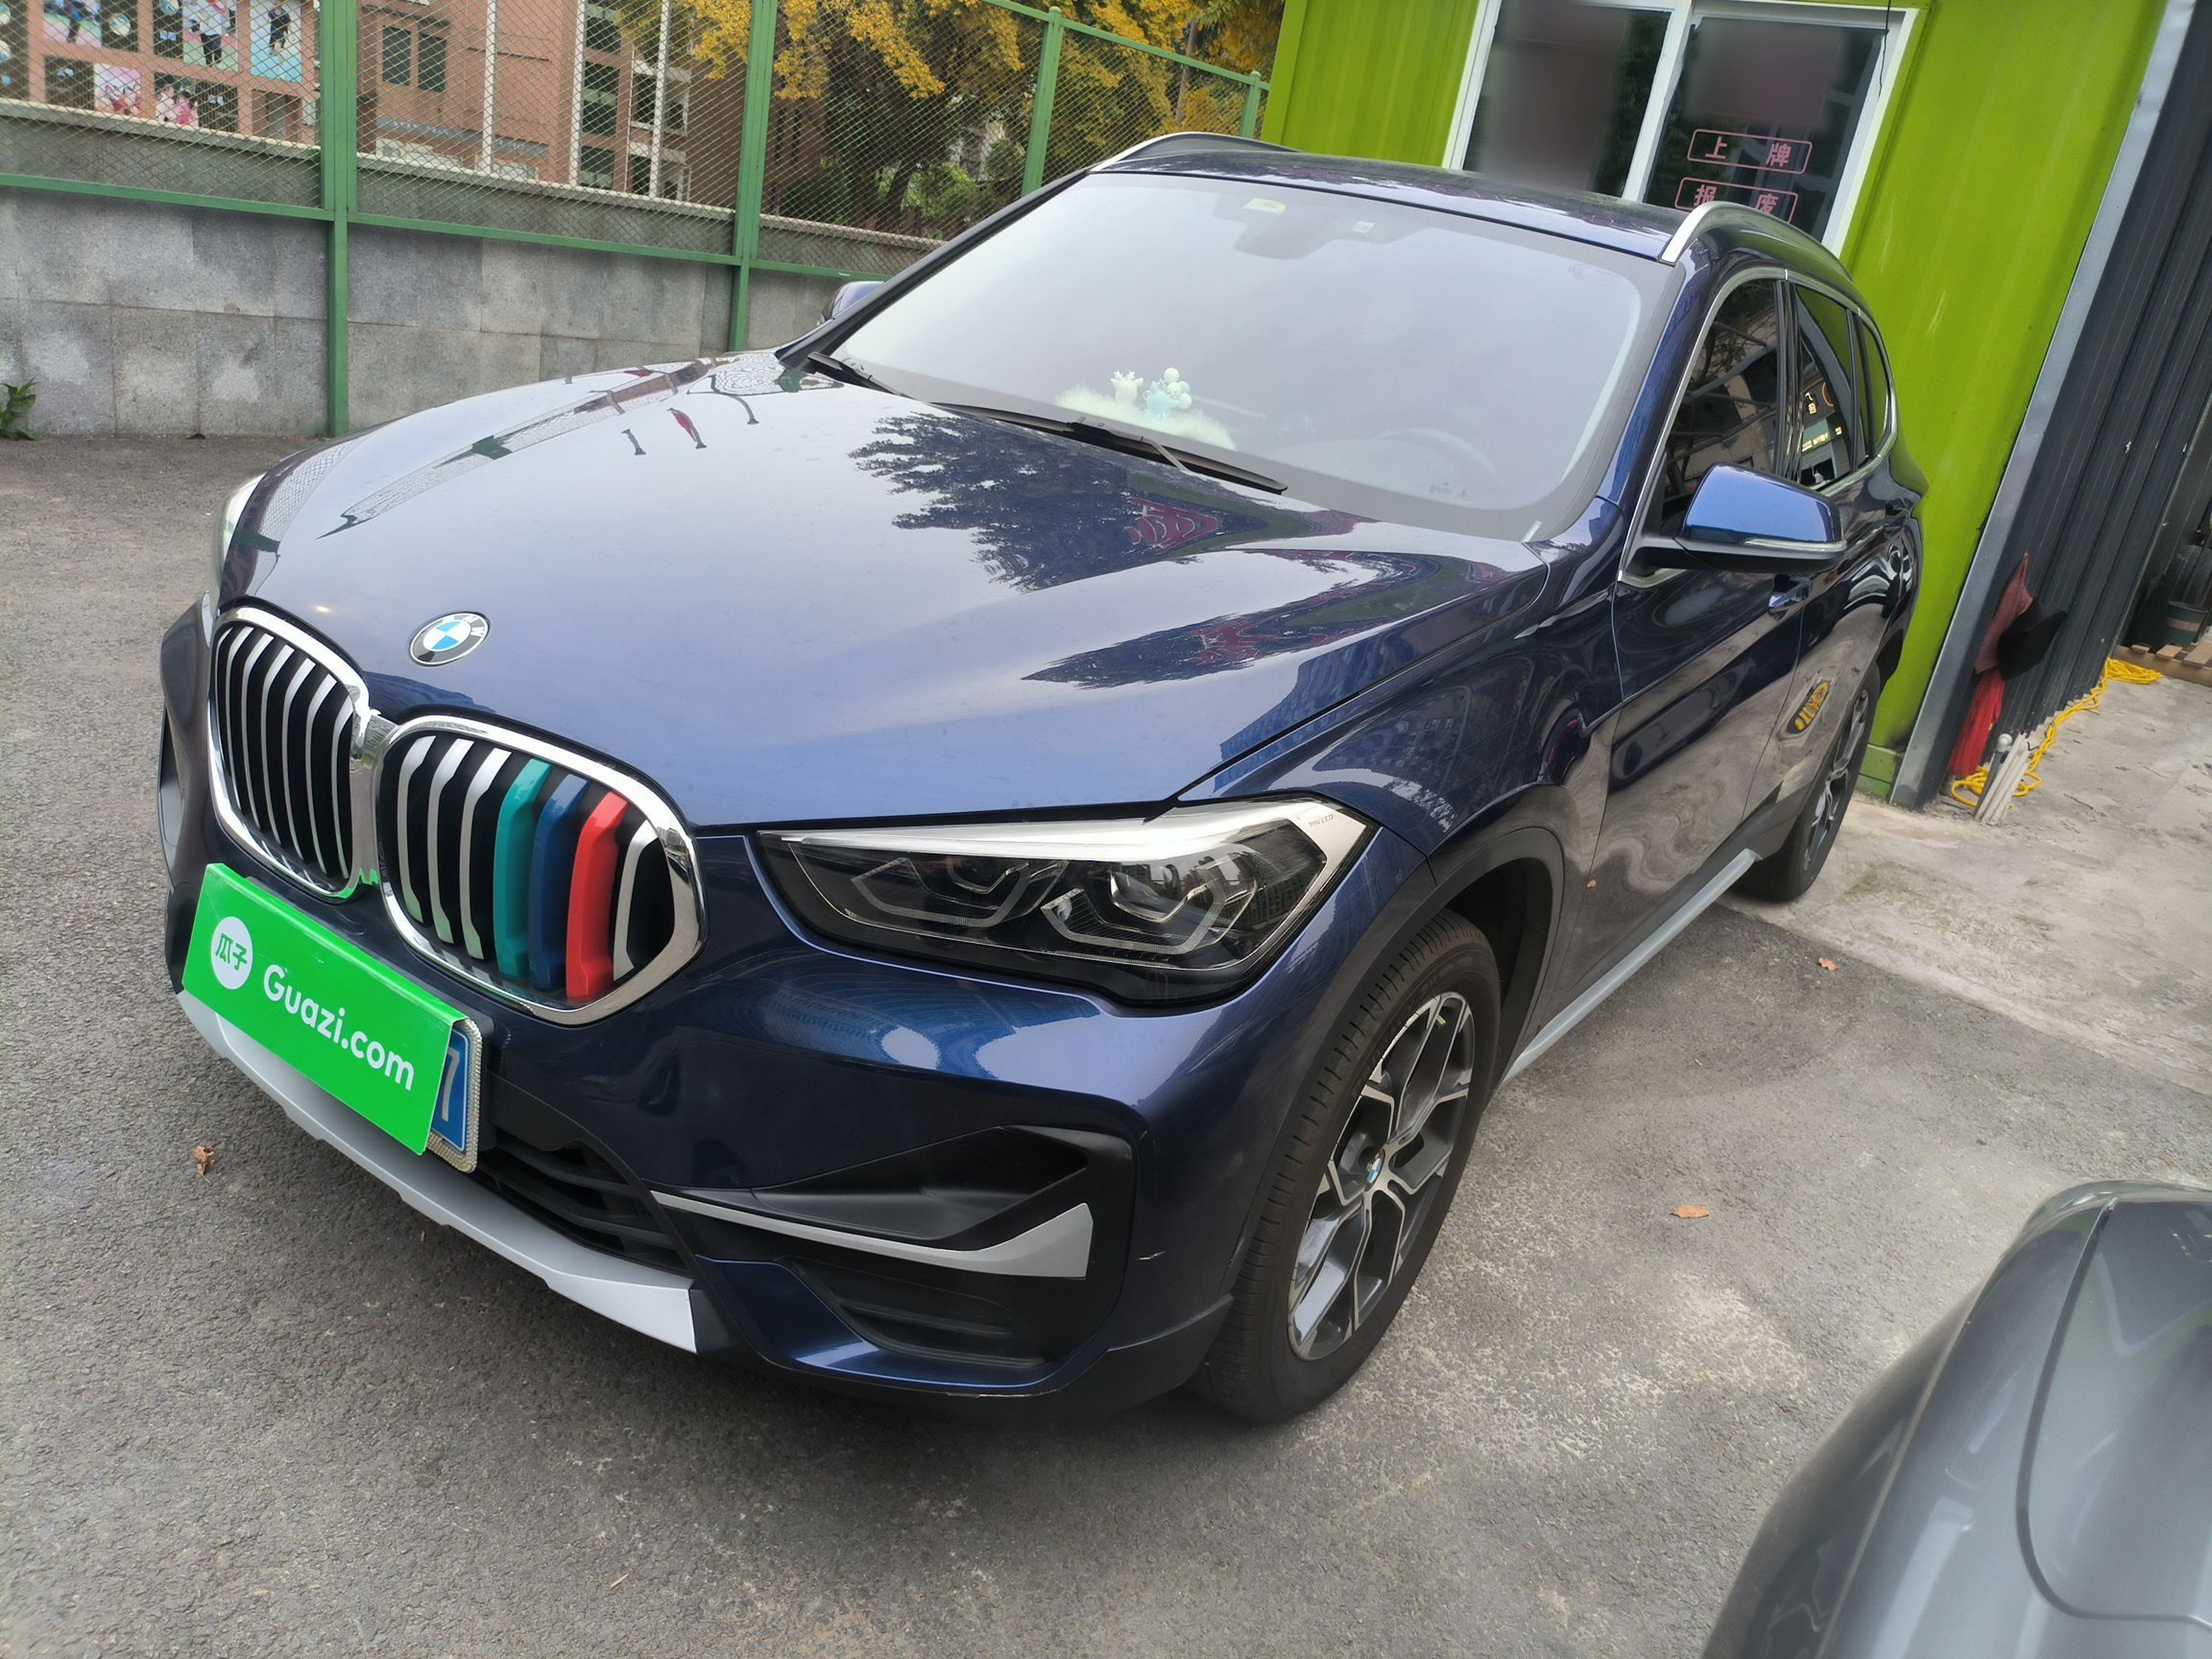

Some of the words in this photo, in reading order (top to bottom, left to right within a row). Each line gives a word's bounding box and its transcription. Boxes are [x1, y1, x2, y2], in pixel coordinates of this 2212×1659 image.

[1705, 137, 1791, 167] 上牌
[1321, 814, 1334, 824] LED
[215, 933, 247, 971] 瓜子
[263, 964, 414, 1091] Guazi.com
